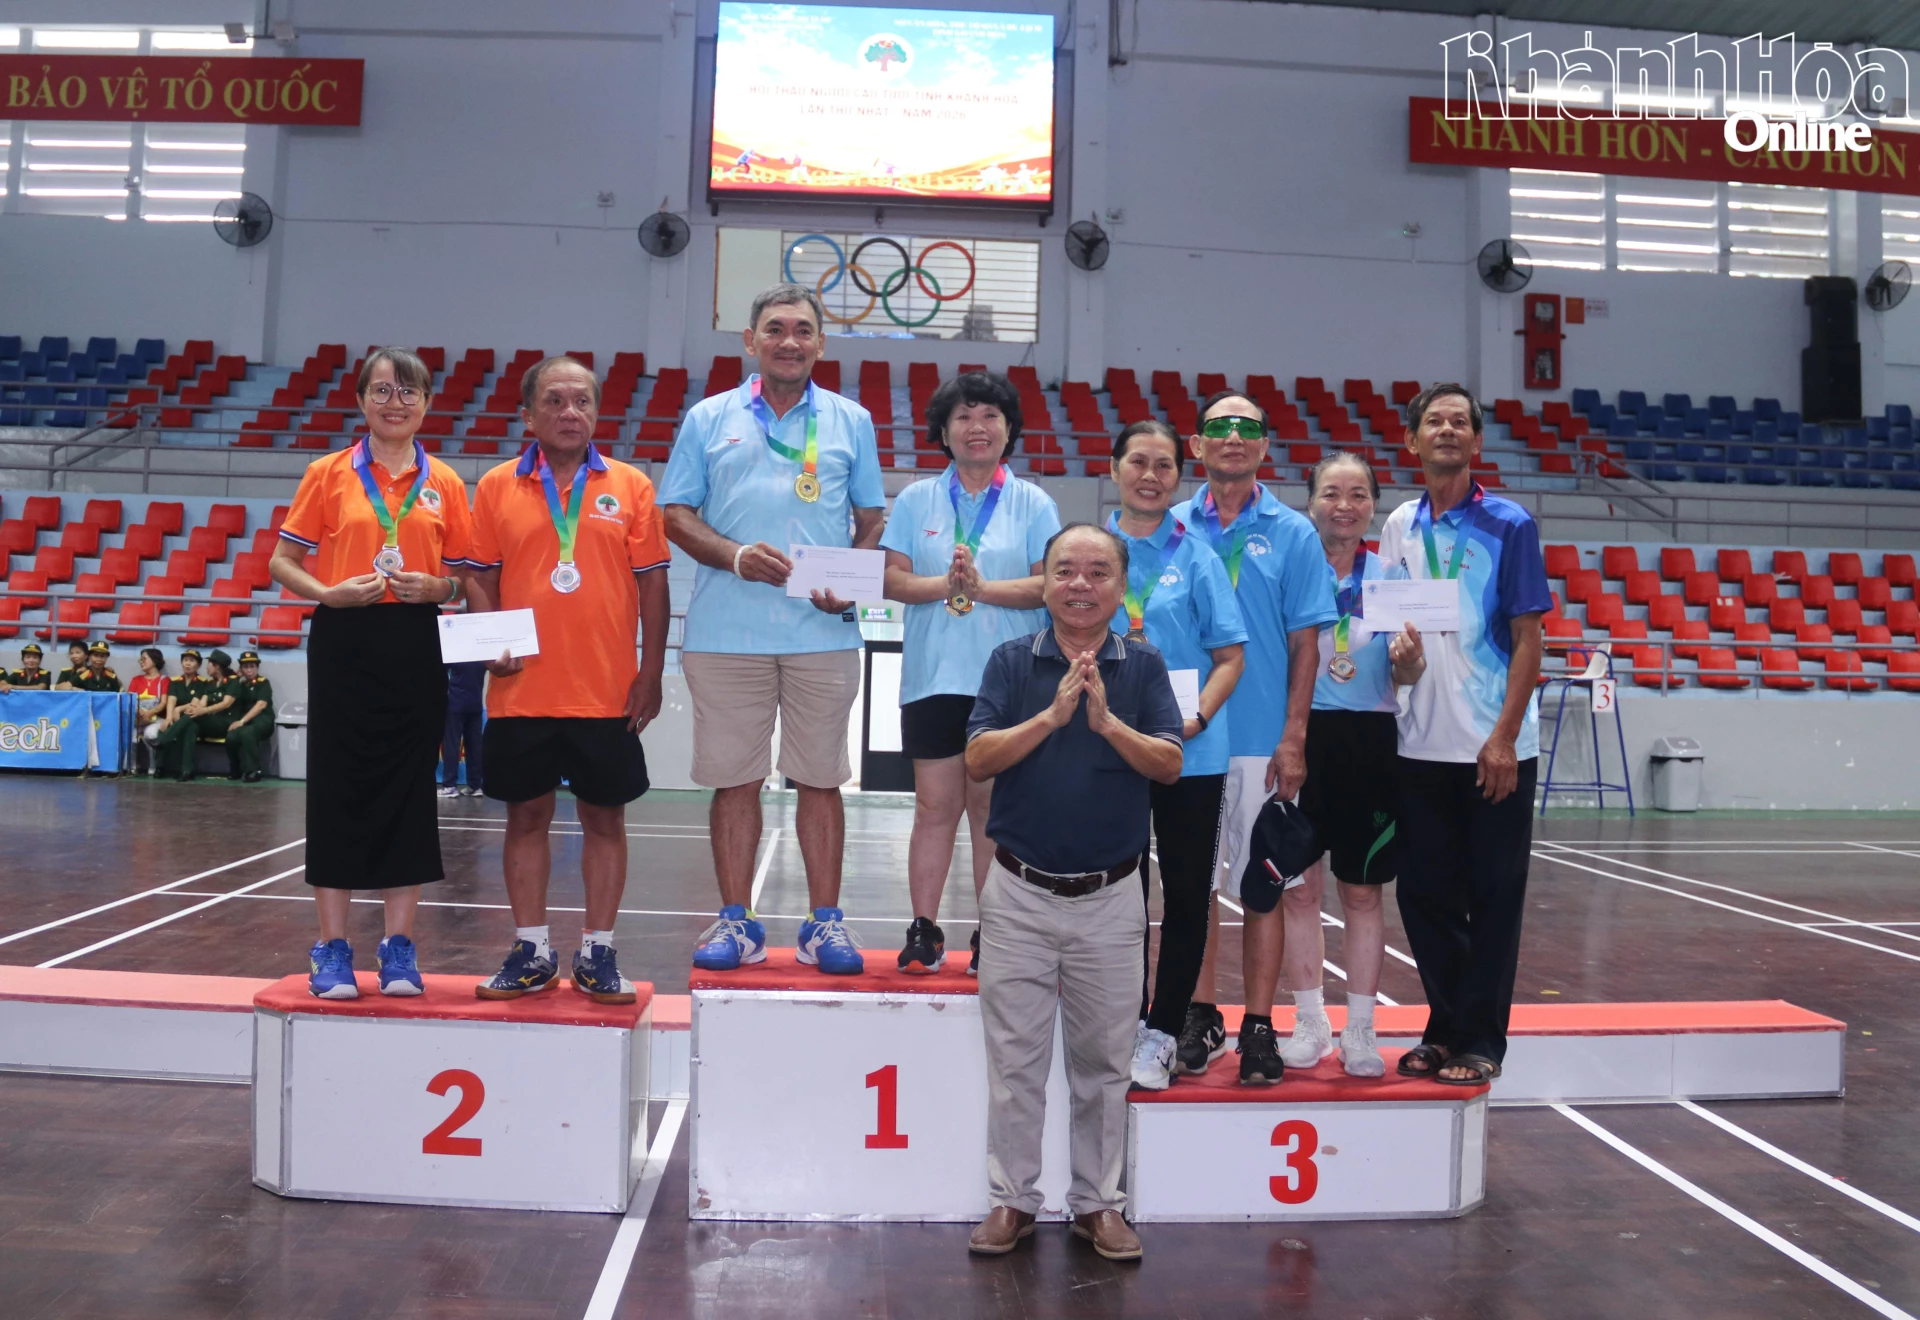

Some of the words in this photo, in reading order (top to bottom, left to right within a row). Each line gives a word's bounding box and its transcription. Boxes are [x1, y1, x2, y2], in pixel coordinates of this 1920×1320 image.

[7, 65, 87, 108] BẢO
[99, 67, 149, 118] VỆ
[160, 61, 213, 110] TỔ
[223, 63, 338, 118] QUỐC
[1430, 110, 1585, 157] NHANH
[1597, 118, 1689, 164] HƠN
[1596, 683, 1611, 709] 3
[422, 1069, 485, 1157] 2
[865, 1065, 909, 1149] 1
[1269, 1119, 1319, 1205] 3
